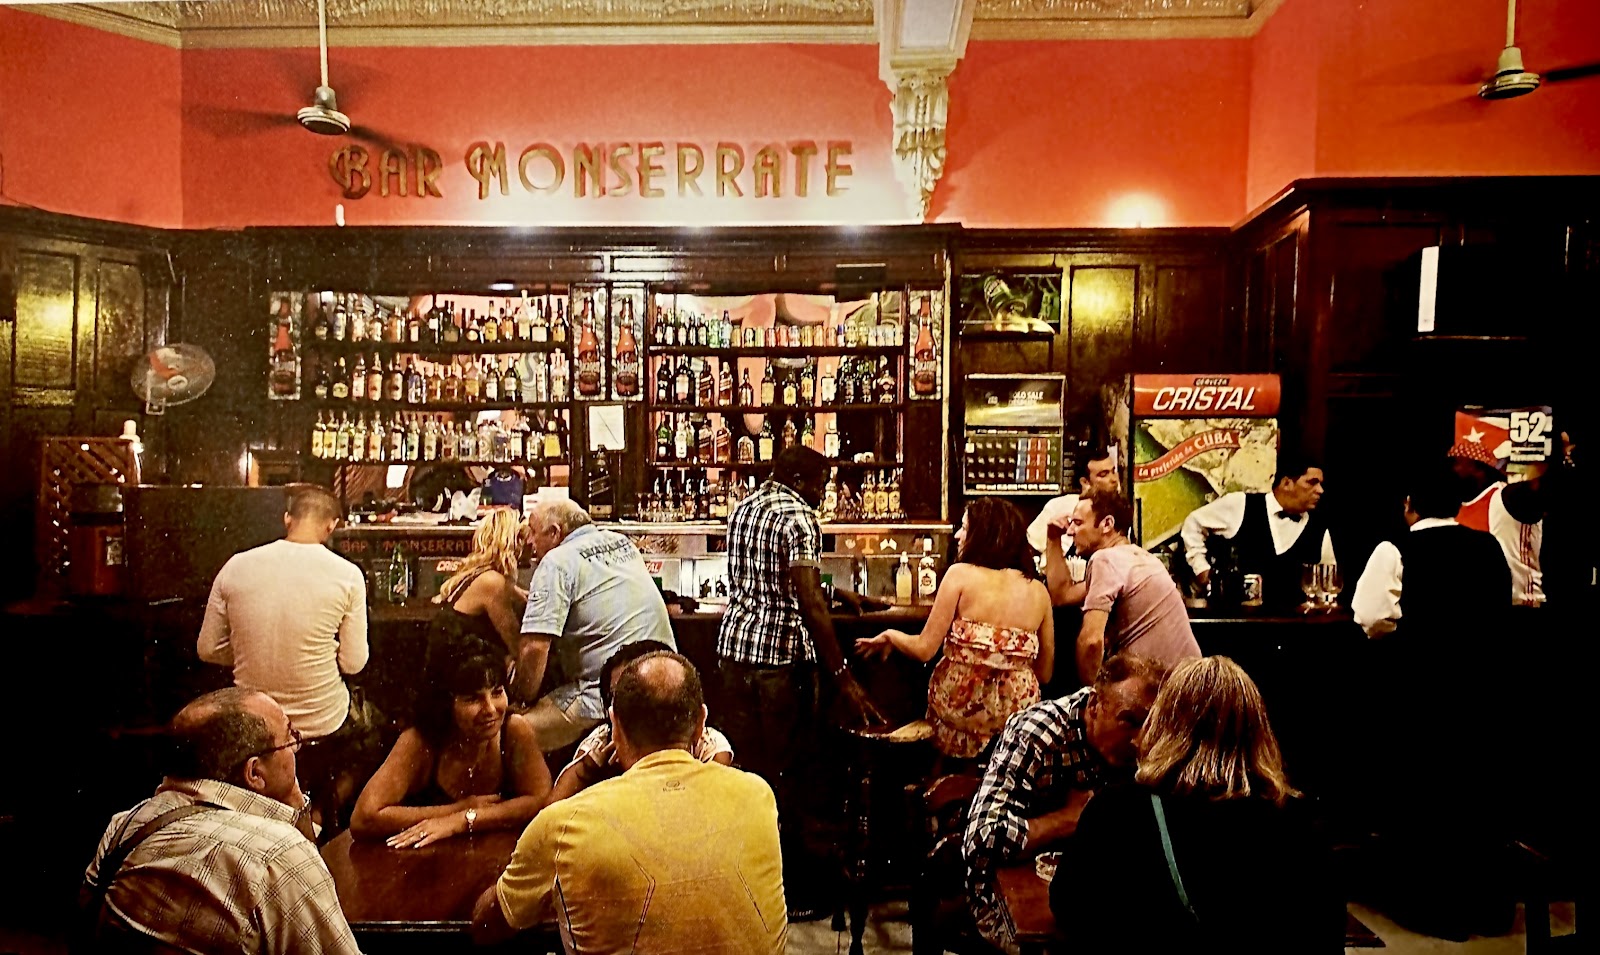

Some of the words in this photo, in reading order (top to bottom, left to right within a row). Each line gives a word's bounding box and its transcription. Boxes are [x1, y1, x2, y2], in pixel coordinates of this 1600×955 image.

[329, 142, 443, 200] BAR
[464, 139, 853, 200] MONSERRATE
[1153, 387, 1255, 411] CRISTAL
[1510, 411, 1547, 443] 52
[1138, 467, 1149, 477] La
[1184, 445, 1194, 455] de
[1194, 432, 1233, 450] CUBA
[382, 539, 473, 552] MONSERRAT
